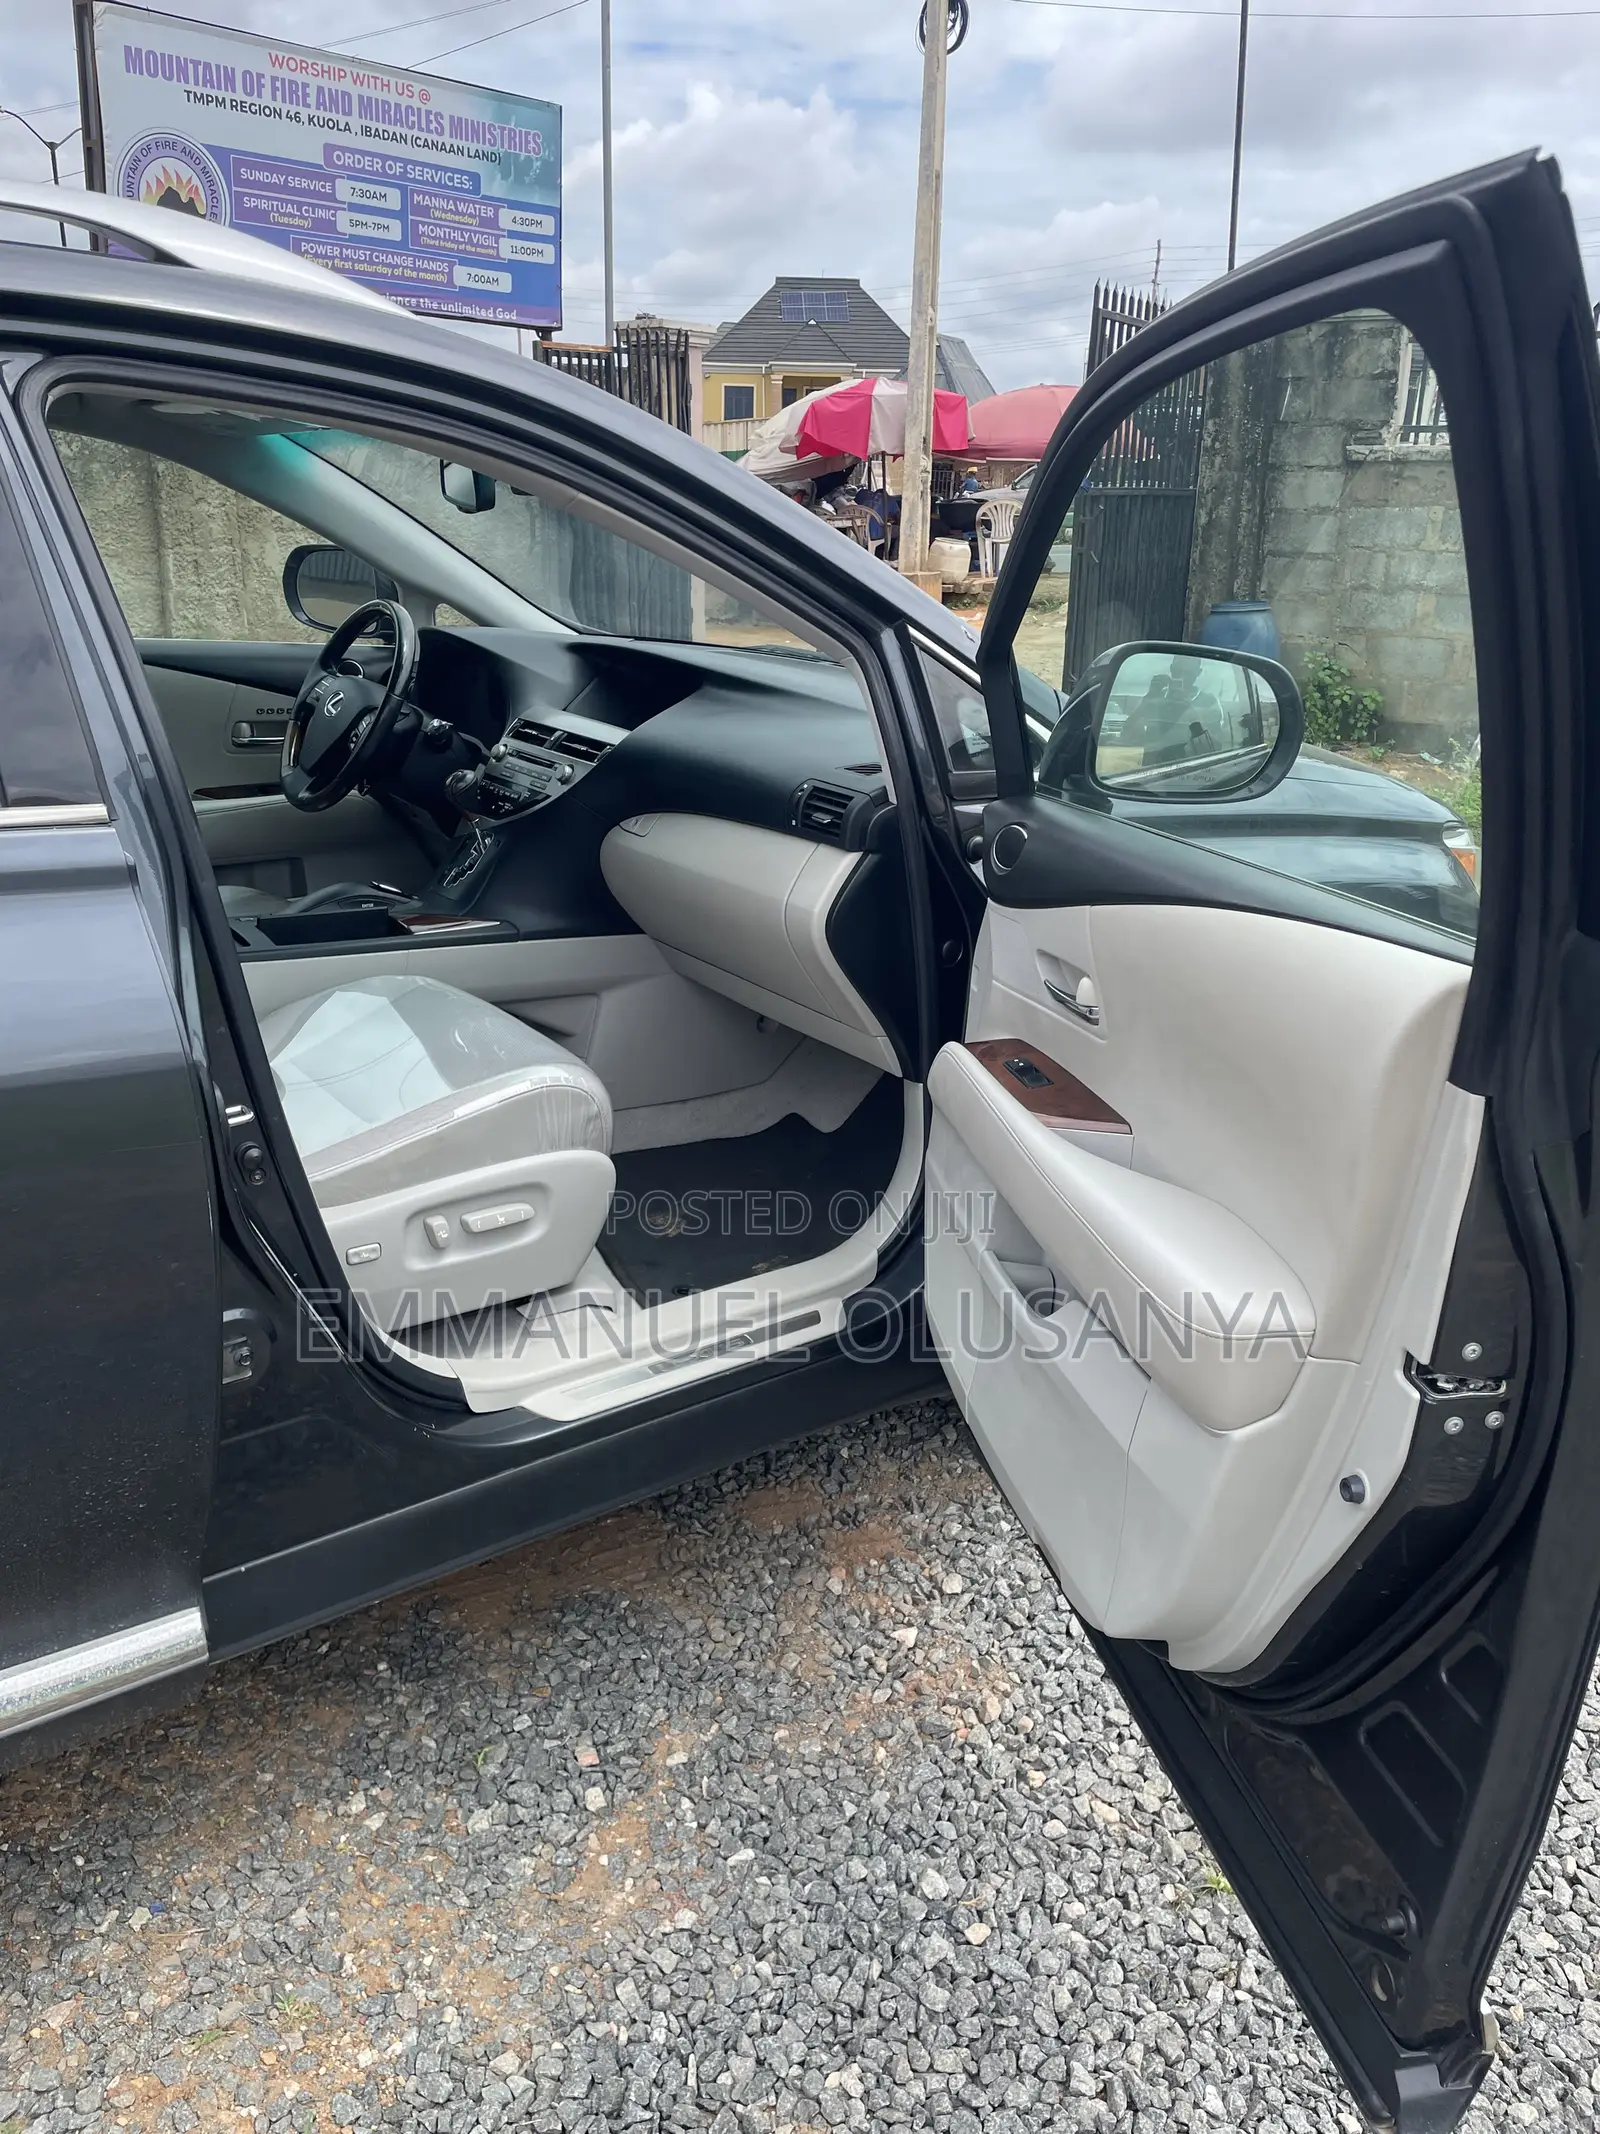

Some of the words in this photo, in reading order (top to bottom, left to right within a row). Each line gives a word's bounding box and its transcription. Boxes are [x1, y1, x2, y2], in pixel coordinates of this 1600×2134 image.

[268, 52, 347, 82] WORSHIP
[351, 70, 390, 93] WITH
[395, 81, 414, 98] US
[419, 89, 430, 104] @
[124, 45, 236, 93] MOUNTAIN
[242, 70, 265, 99] OF
[270, 75, 311, 109] FIRE
[315, 85, 352, 116] AND
[358, 94, 444, 136] MIRACLES
[449, 114, 542, 156] MINISTRIES
[184, 89, 226, 109] TMPM
[230, 98, 282, 120] REGION
[286, 110, 304, 126] 46,
[308, 114, 352, 134] KUOLA
[360, 125, 407, 145] IBADAN
[411, 135, 464, 158] (CANAAN
[468, 147, 501, 166] LAND)
[127, 156, 142, 197] UNTAIN
[141, 144, 152, 157] OF
[155, 141, 178, 151] FIRE
[181, 147, 201, 166] AND
[200, 166, 219, 221] MIRACLE
[240, 168, 286, 185] SUNDAY
[288, 176, 332, 193] SERVICE
[333, 151, 382, 172] ORDER
[385, 161, 403, 176] OF
[407, 164, 472, 189] SERVICES:
[350, 187, 387, 202] 7:30AM
[414, 193, 455, 210] MANNA
[457, 203, 494, 218] WATER
[244, 197, 300, 214] SPIRITUAL
[302, 206, 335, 220] CLINIC
[430, 209, 479, 226] (Wednesday)
[270, 213, 311, 228] (Tuesday)
[350, 219, 389, 232] 5PM-7PM
[512, 216, 542, 228] 4:30PM
[419, 224, 470, 241] MONTHLY
[471, 233, 498, 247] VIGIL
[421, 237, 439, 246] (Third
[301, 242, 340, 256] POWER
[343, 249, 371, 260] MUST
[373, 254, 414, 267] CHANGE
[416, 261, 449, 272] HANDS
[511, 245, 543, 257] 11:00PM
[334, 258, 352, 269] first
[354, 262, 392, 276] saturday
[394, 267, 402, 276] of
[404, 269, 417, 278] the
[419, 271, 447, 283] month)
[467, 273, 499, 286] 7:00AM
[420, 298, 438, 310] the
[442, 301, 493, 317] unlimited
[496, 308, 516, 319] God
